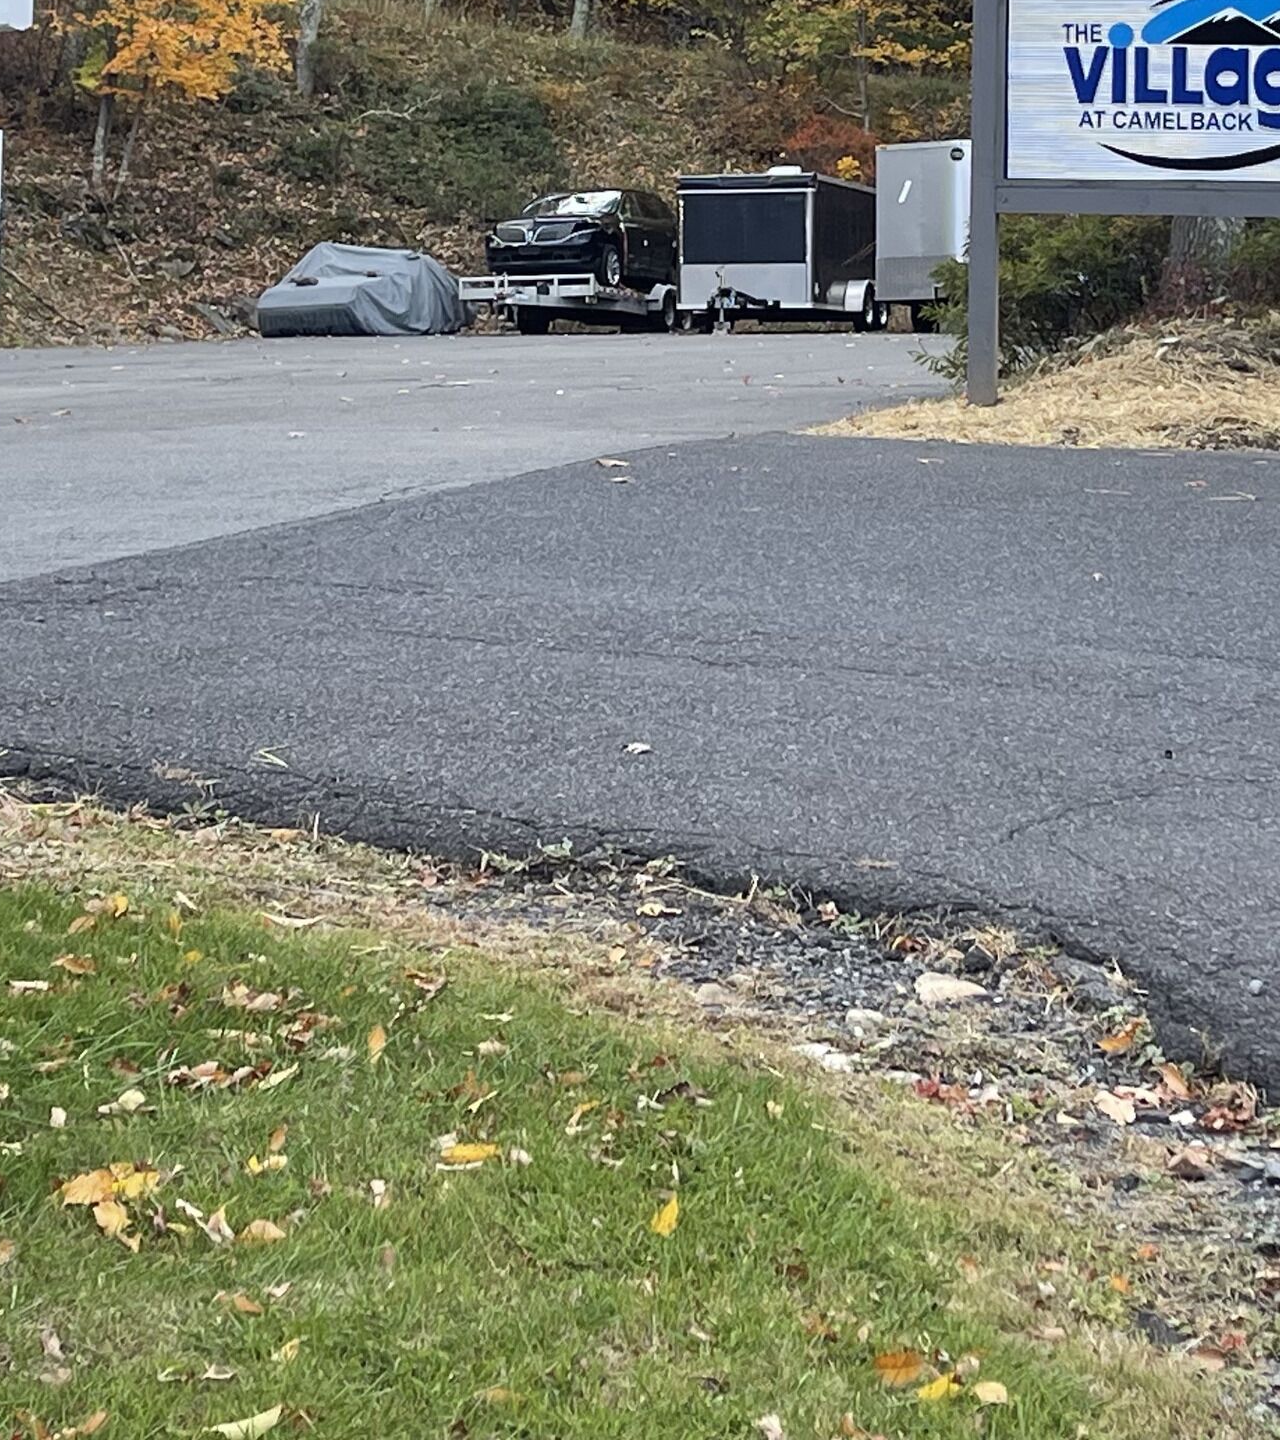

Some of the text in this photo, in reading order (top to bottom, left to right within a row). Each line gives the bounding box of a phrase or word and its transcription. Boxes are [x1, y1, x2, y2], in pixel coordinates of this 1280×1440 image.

[1062, 23, 1103, 43] THE
[1079, 111, 1253, 131] AT CAMELBACK
